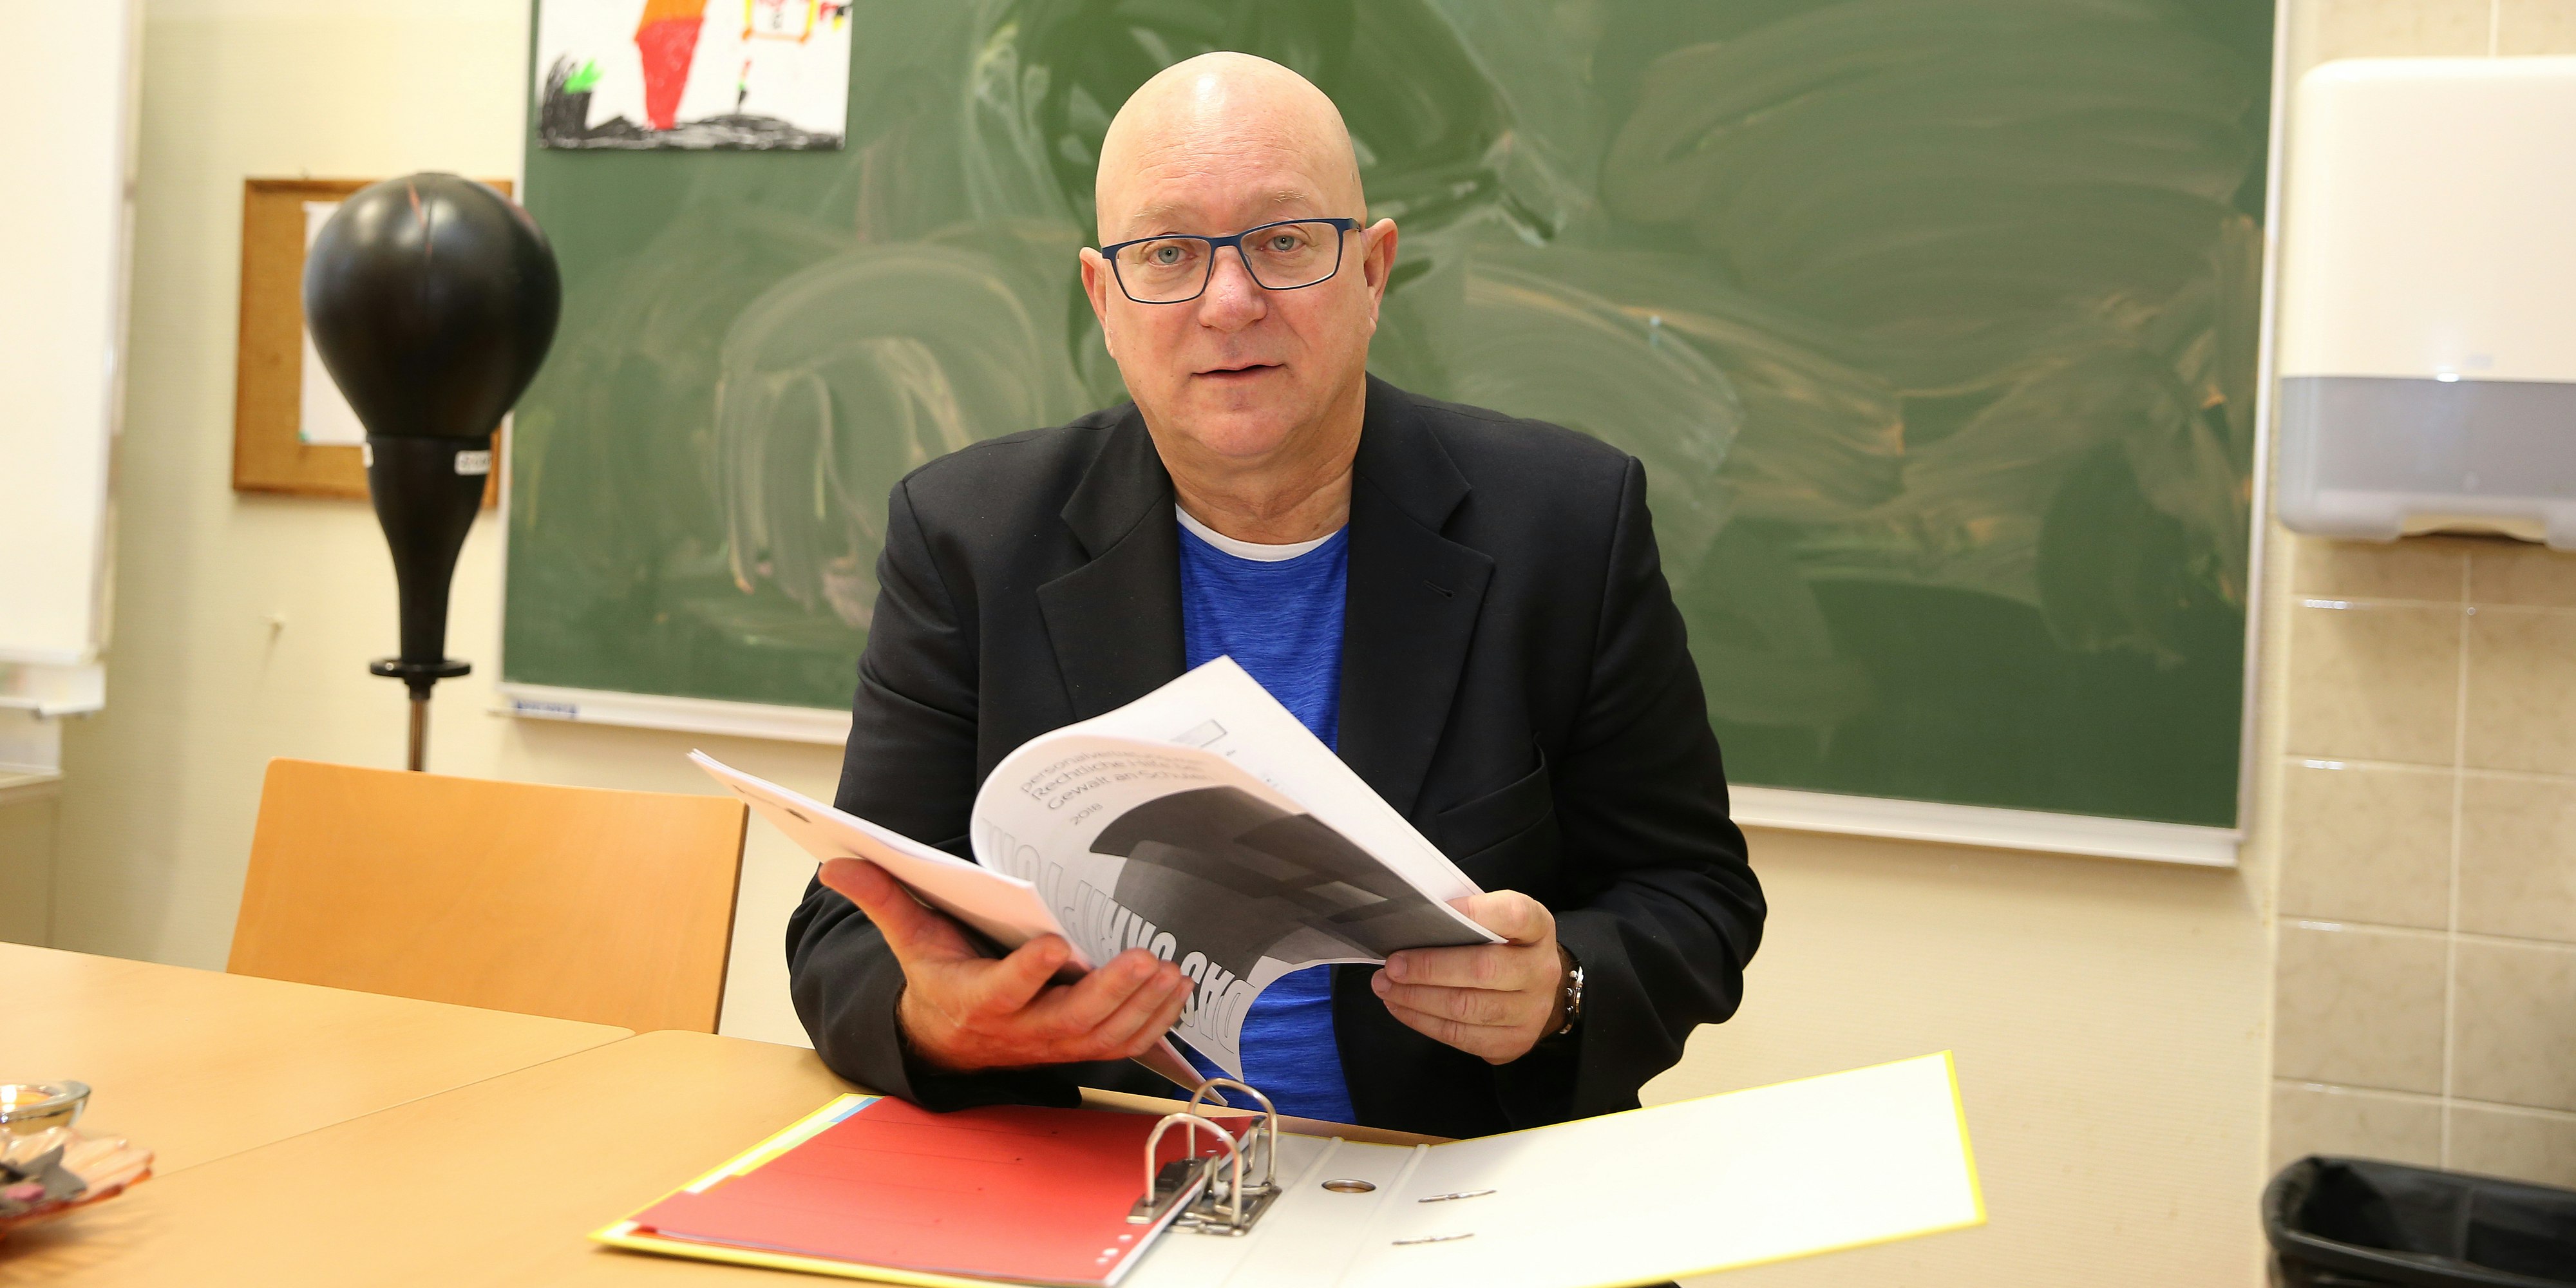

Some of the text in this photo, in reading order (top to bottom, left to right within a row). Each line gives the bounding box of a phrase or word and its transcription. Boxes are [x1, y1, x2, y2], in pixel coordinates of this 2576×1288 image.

[1032, 759, 1125, 800] Rechtliche
[1048, 775, 1112, 810] Gewalt
[1113, 772, 1139, 781] an
[1070, 802, 1103, 826] 2018
[1178, 951, 1256, 1054] DAS
